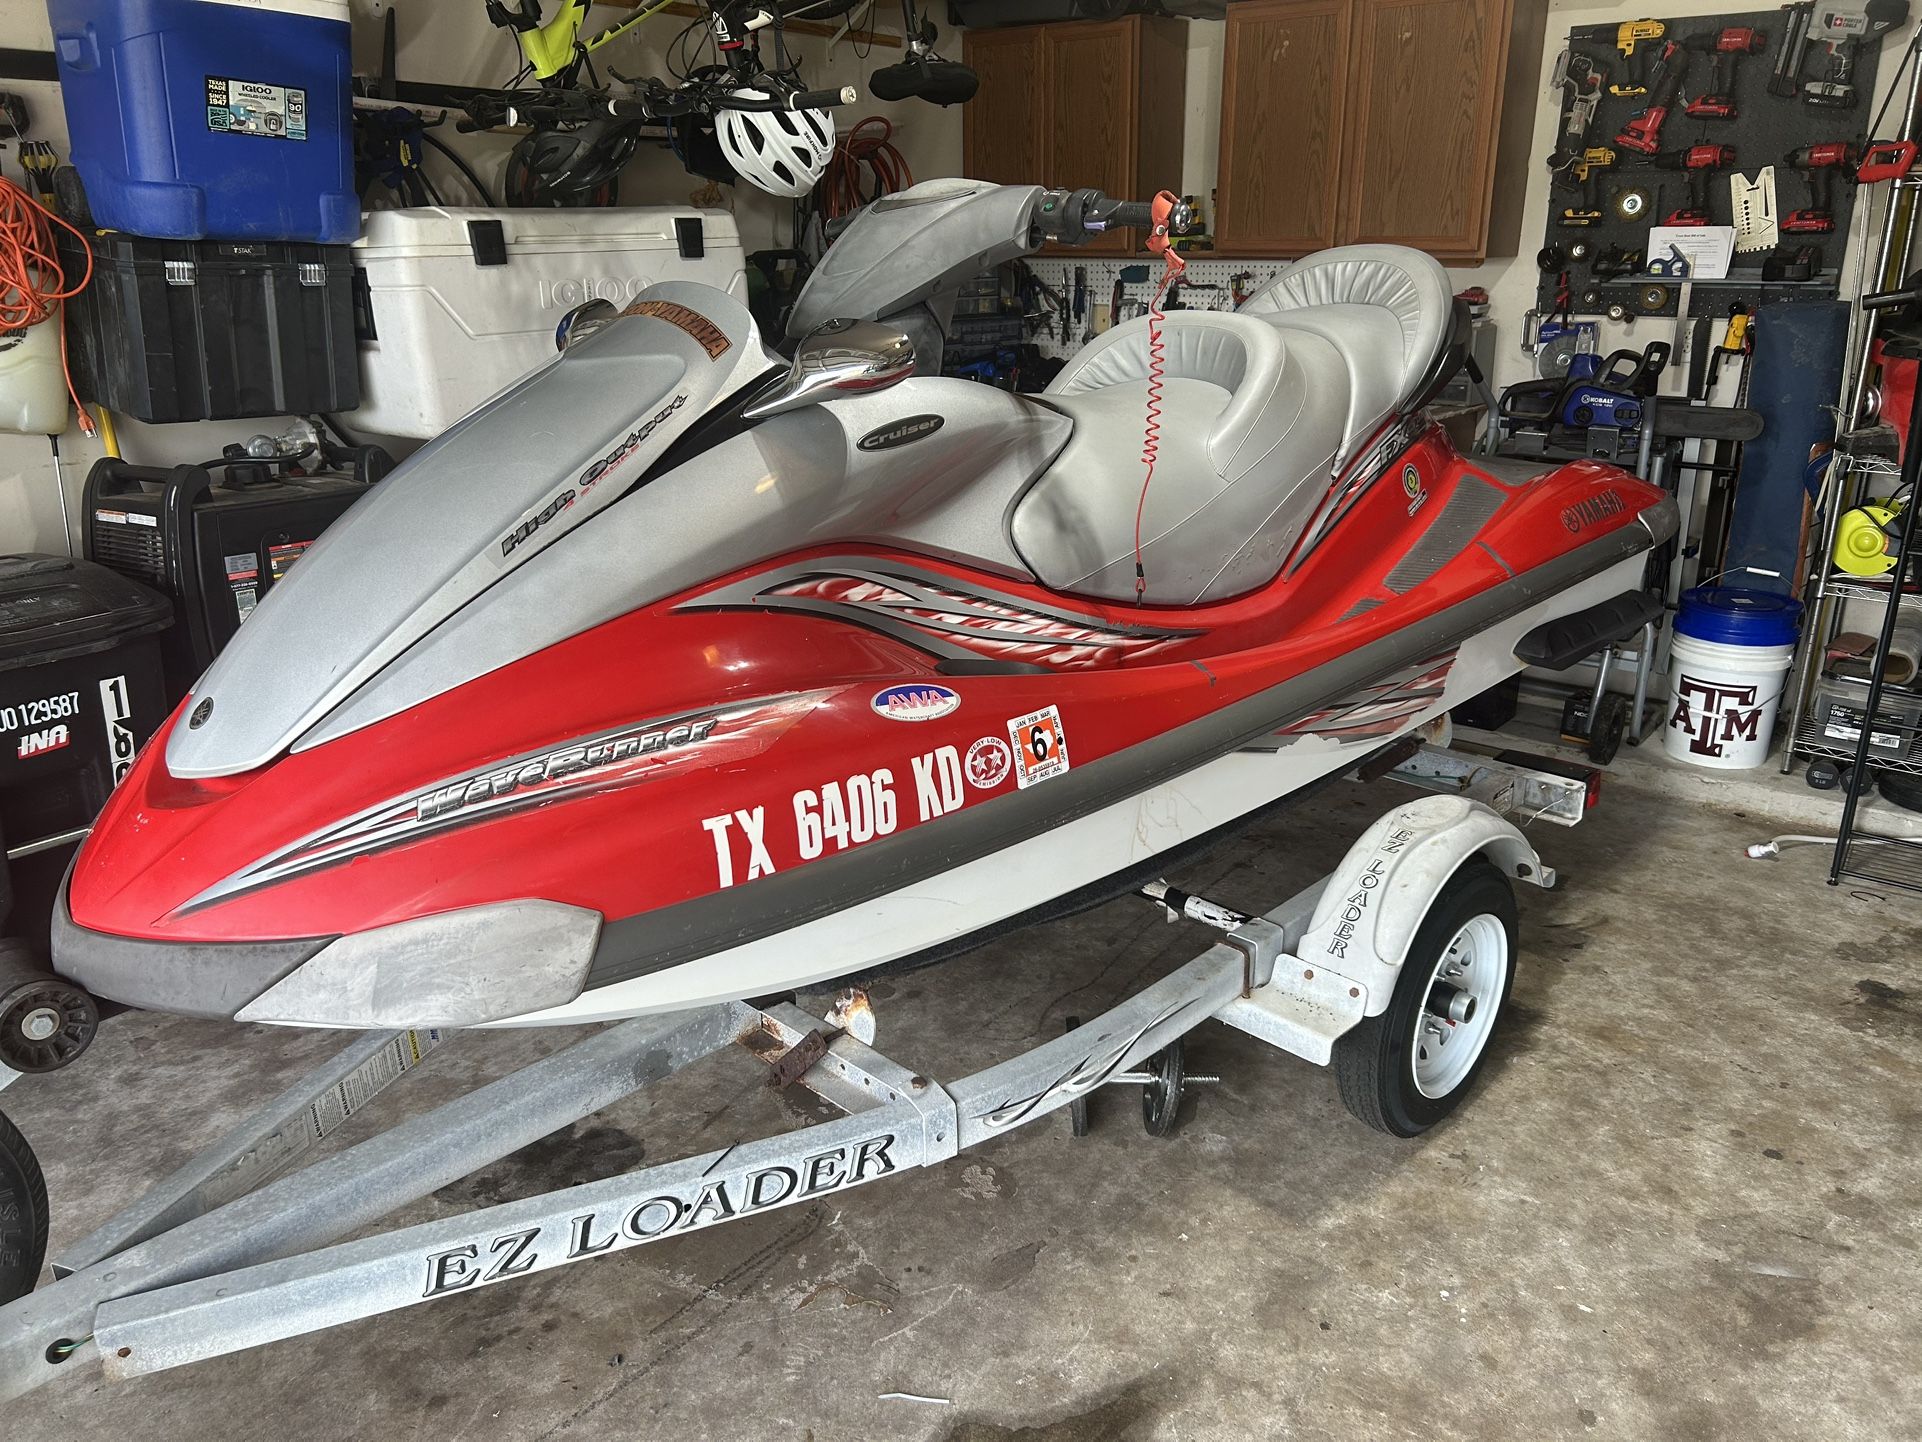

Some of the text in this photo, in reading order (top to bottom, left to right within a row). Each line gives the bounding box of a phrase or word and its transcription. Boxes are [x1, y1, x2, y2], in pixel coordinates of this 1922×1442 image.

[242, 84, 272, 95] IGLOO
[288, 103, 302, 112] 90
[540, 276, 653, 310] IGLOO
[653, 302, 731, 359] YAMAHA
[864, 418, 939, 448] Cruiser
[502, 395, 688, 557] High Output
[580, 444, 641, 496] STROKE
[1574, 489, 1626, 527] YAMAHA
[18, 691, 80, 726] 129587
[888, 690, 949, 712] AWA
[1016, 710, 1050, 728] JAN FEB MAR
[1030, 726, 1048, 762] 6
[416, 718, 718, 821] WaveRunner
[1027, 774, 1038, 782] SEP
[702, 745, 965, 888] TX 6406 KD
[1327, 828, 1413, 959] EZ LOADER
[395, 1038, 404, 1066] WARNING
[339, 1082, 348, 1110] WARNING
[310, 1103, 320, 1132] WARNING
[422, 1134, 896, 1298] EZ LOADER
